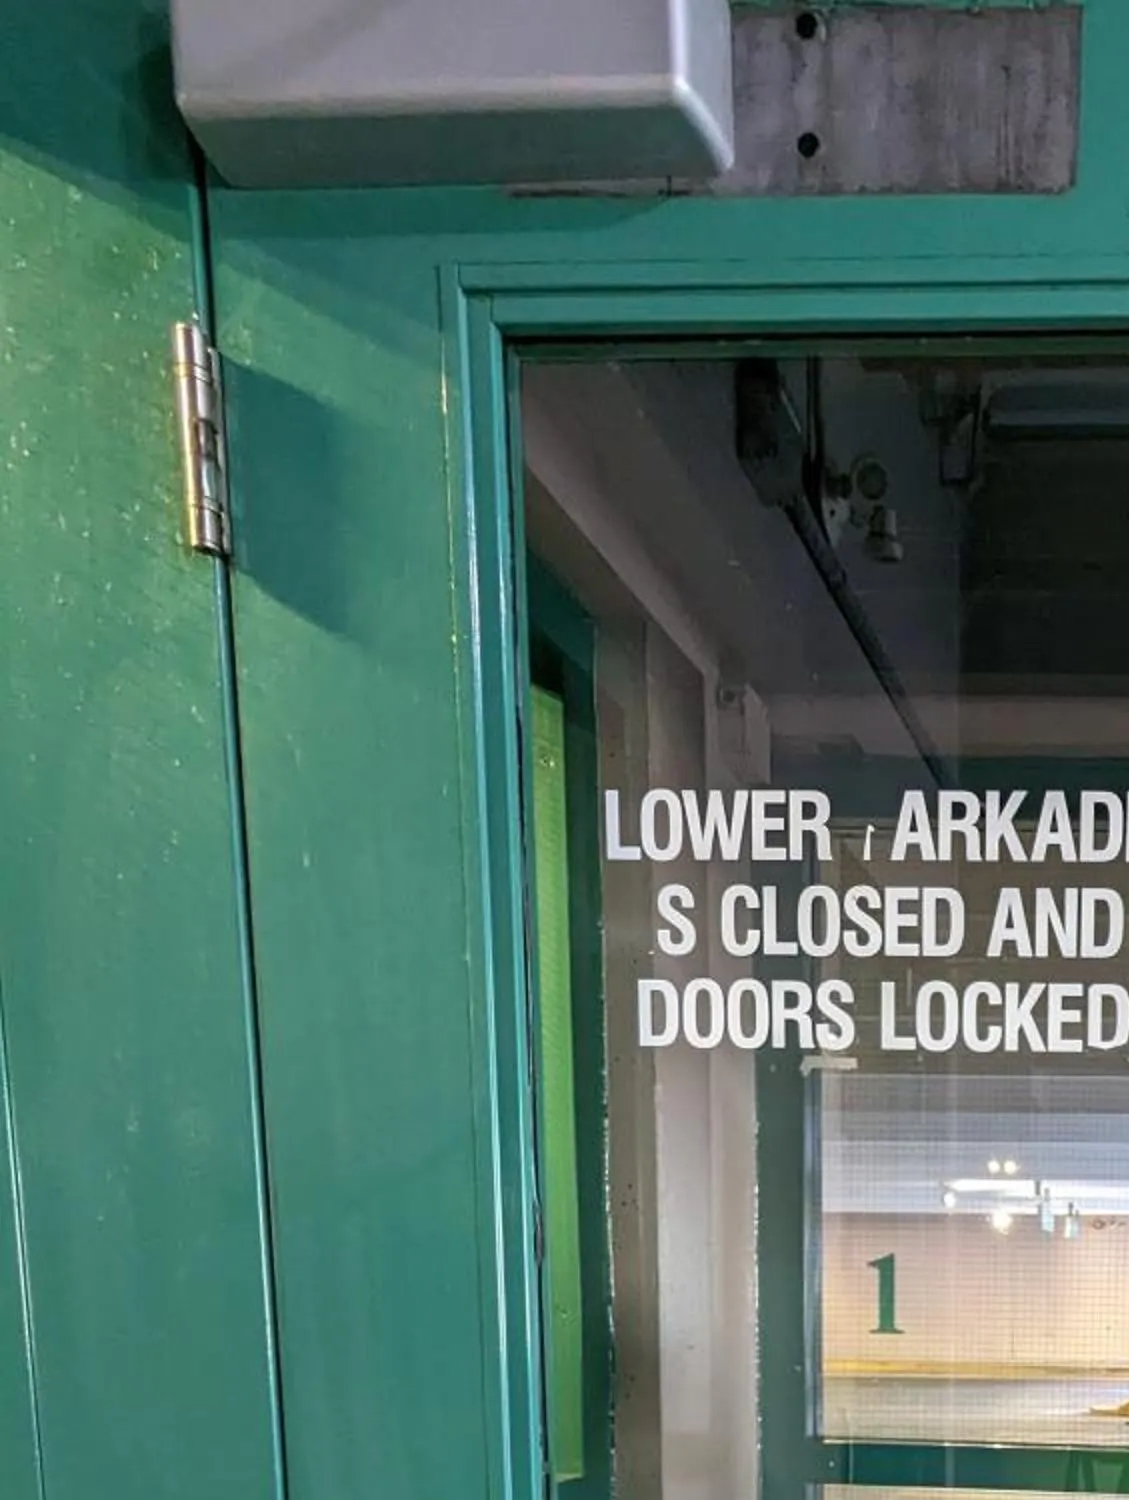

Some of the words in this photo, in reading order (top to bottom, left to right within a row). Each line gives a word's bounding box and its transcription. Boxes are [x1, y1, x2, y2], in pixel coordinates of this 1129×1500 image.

[604, 788, 833, 862] LOWER
[656, 883, 698, 957] S
[720, 883, 966, 958] CLOSED
[986, 886, 1125, 959] AND
[636, 977, 856, 1051] DOORS
[866, 1251, 906, 1335] 1
